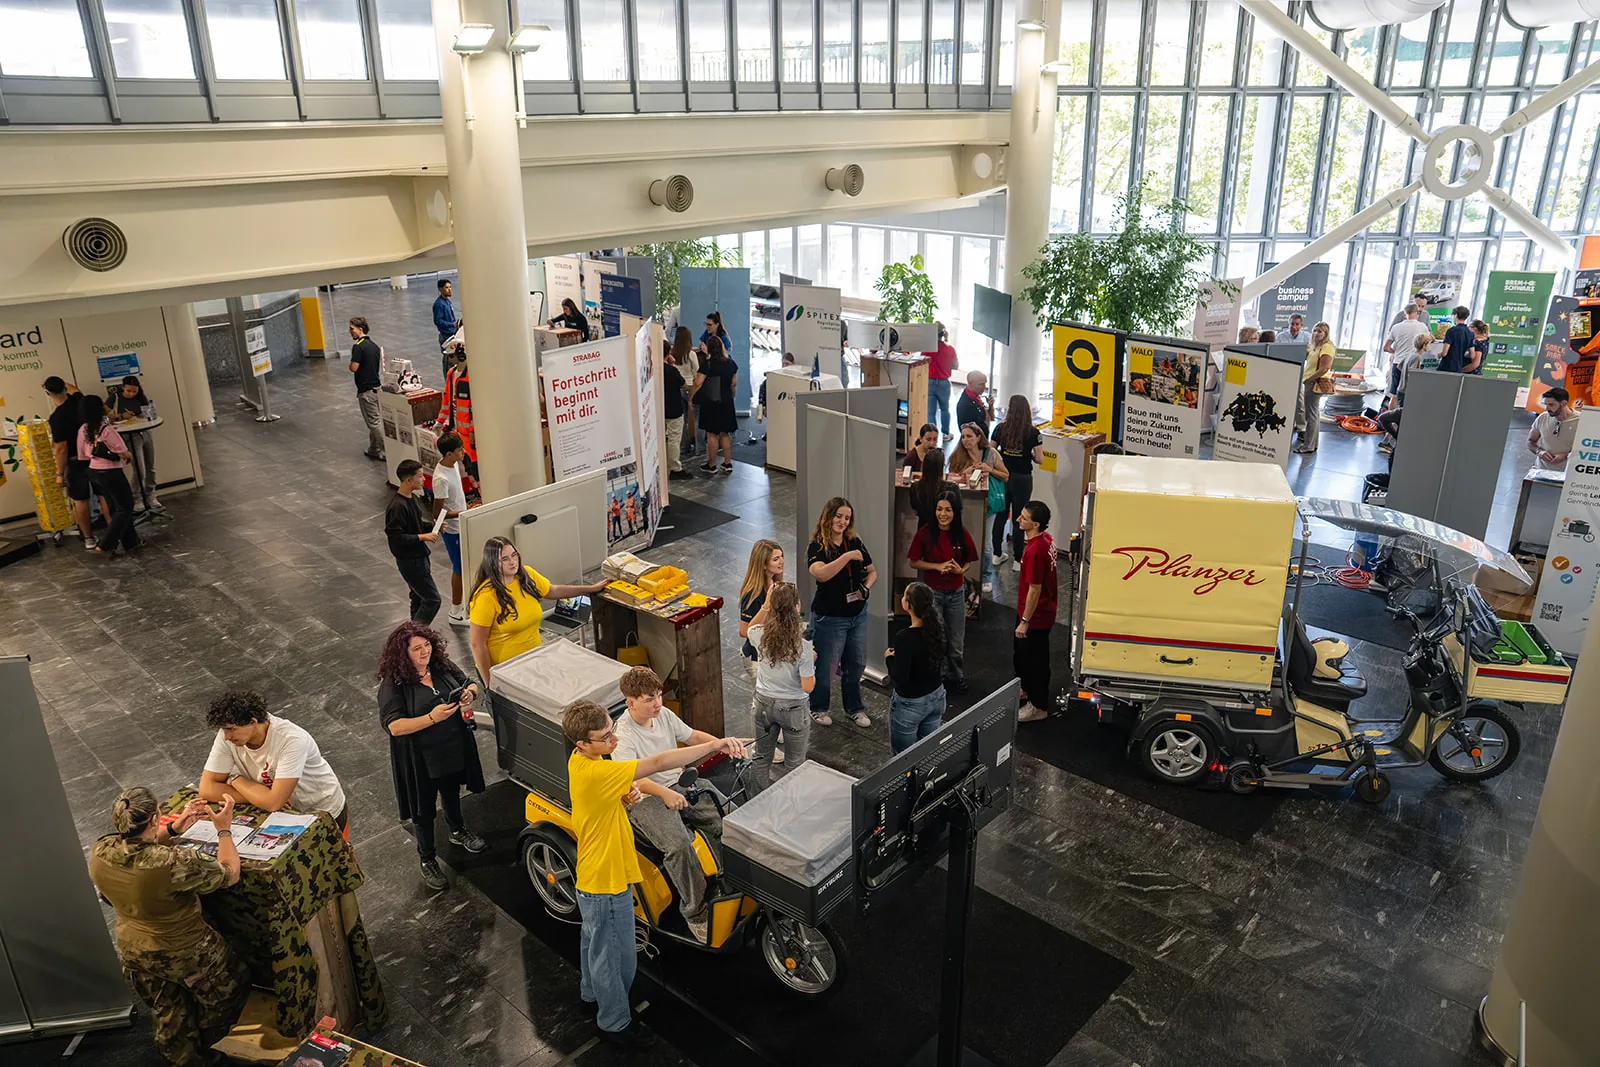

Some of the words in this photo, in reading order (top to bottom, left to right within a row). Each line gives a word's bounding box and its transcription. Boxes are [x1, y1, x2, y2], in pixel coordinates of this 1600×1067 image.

[1278, 286, 1314, 295] business
[1277, 293, 1309, 302] campus
[806, 311, 840, 321] SPITEX
[91, 343, 120, 355] Deine
[121, 340, 147, 351] Ideen
[1130, 346, 1153, 357] WALO
[3, 349, 39, 361] kommt
[573, 351, 601, 363] STRABAG
[1228, 358, 1247, 369] WALO
[551, 366, 617, 392] Fortschritt
[553, 386, 599, 408] beginnt
[556, 409, 576, 424] mit
[579, 403, 598, 418] dir.
[1127, 406, 1147, 418] Baue
[1149, 410, 1162, 419] mit
[1163, 415, 1179, 423] uns
[1127, 415, 1148, 427] deine
[1149, 420, 1183, 434] Zukunft.
[1126, 425, 1153, 437] Bewirb
[1155, 431, 1172, 441] dich
[1125, 435, 1149, 446] noch
[1146, 438, 1172, 450] heute!
[1579, 450, 1600, 462] VE
[1570, 482, 1600, 491] Gestalte
[1568, 490, 1588, 498] deine
[1111, 546, 1266, 595] Planzer
[532, 802, 550, 815] KYBURZ
[822, 870, 843, 891] KYBURZ
